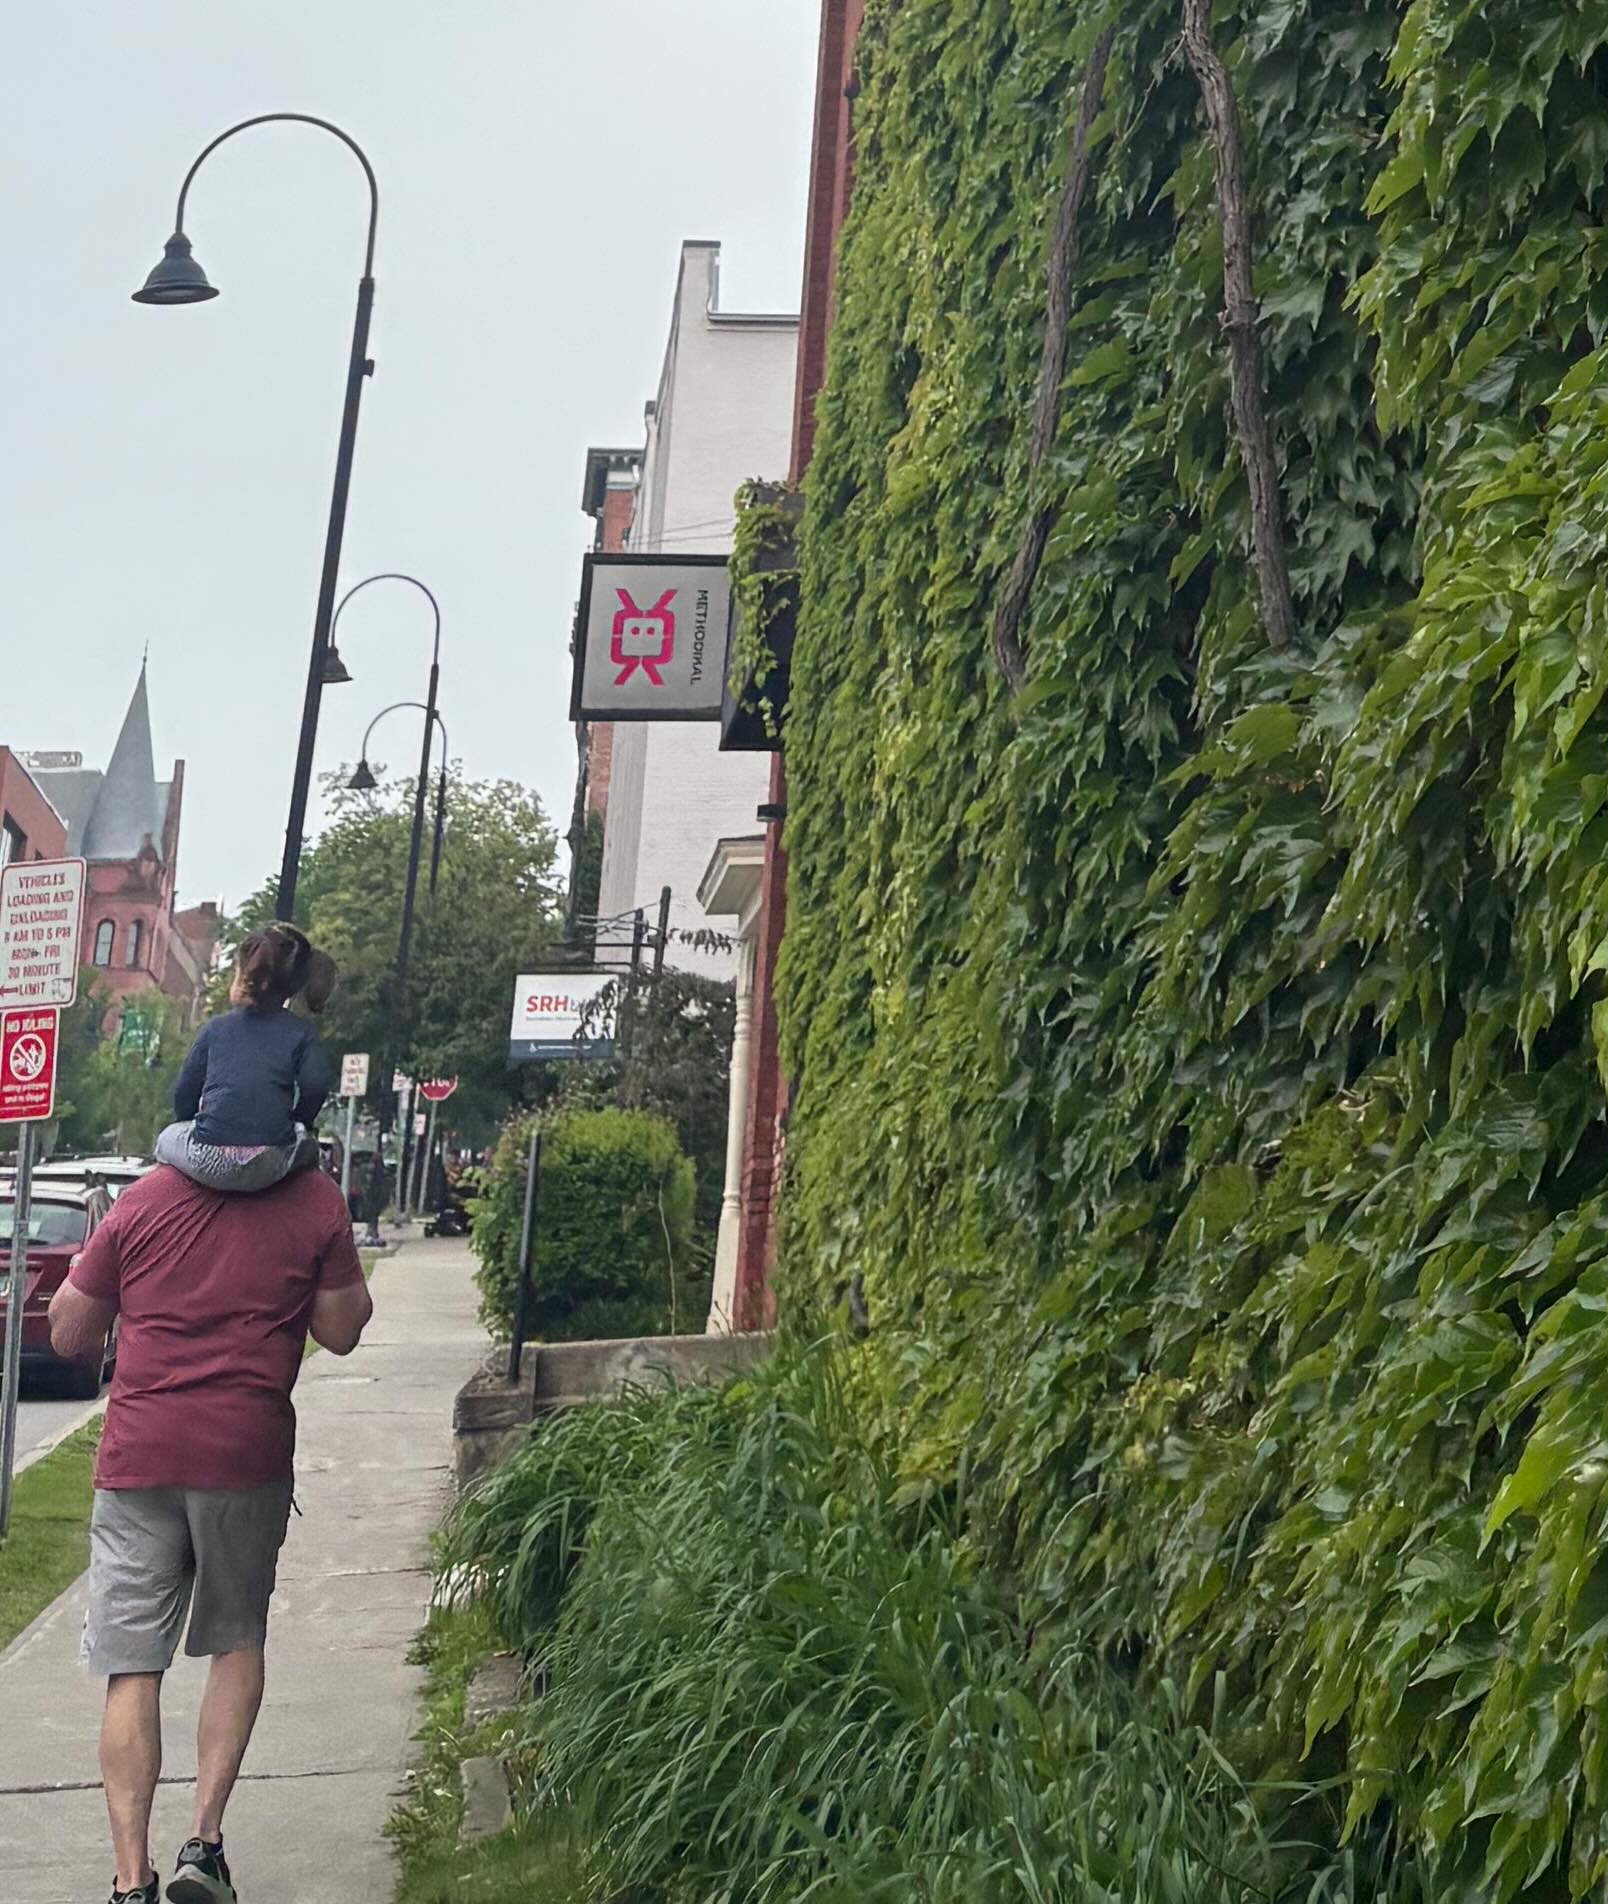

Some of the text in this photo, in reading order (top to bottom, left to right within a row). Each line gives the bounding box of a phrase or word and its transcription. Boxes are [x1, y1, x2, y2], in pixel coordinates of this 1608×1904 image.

[53, 890, 74, 903] AND
[13, 930, 29, 941] AM
[56, 927, 71, 938] PM
[23, 963, 61, 976] MINUTE
[19, 982, 45, 996] LIMIT
